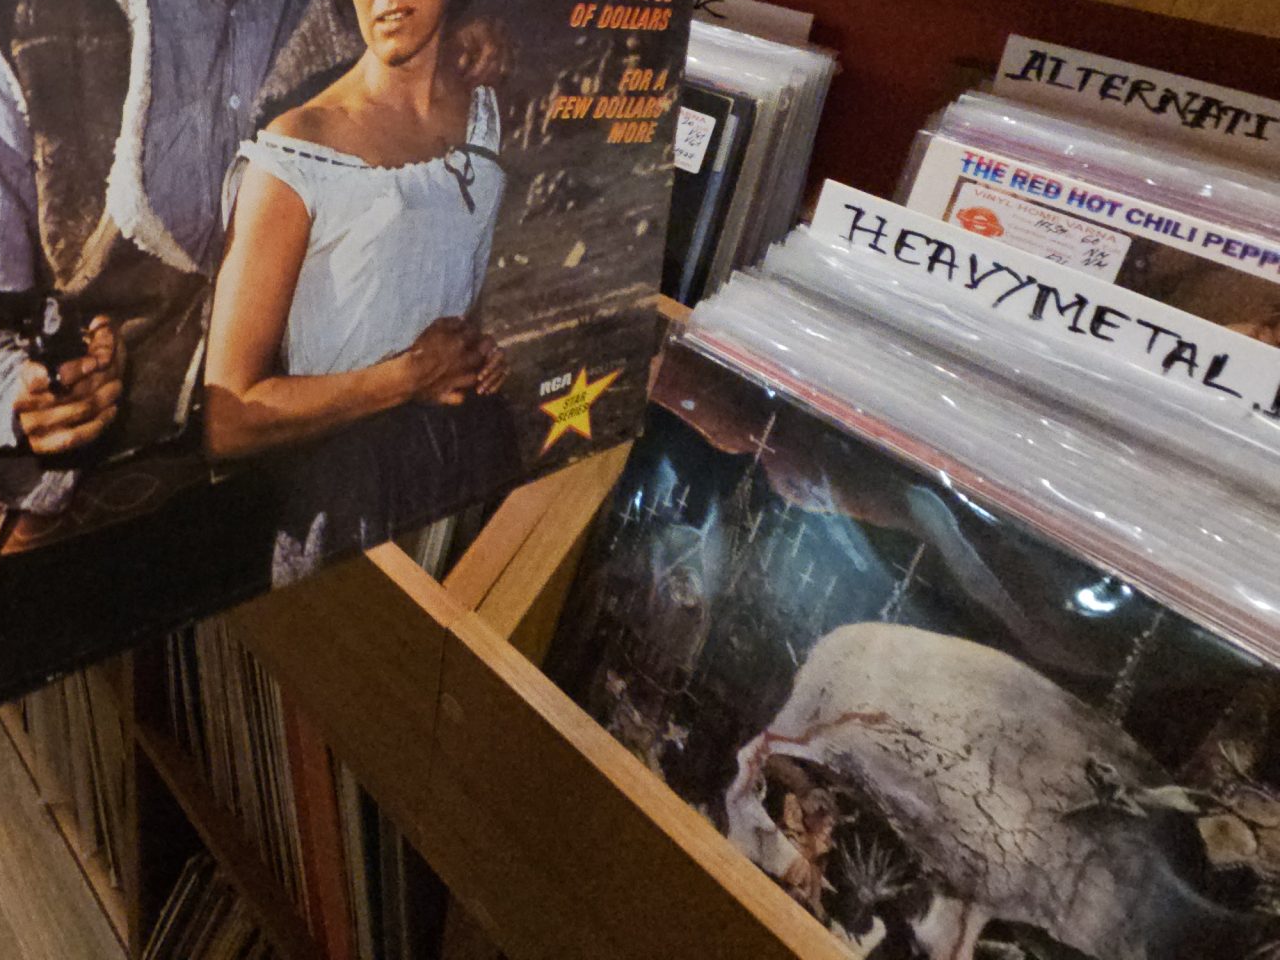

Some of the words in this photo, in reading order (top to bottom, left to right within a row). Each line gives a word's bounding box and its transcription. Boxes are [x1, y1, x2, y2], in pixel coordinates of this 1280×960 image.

[570, 3, 597, 28] OF
[597, 5, 672, 30] DOLLARS
[619, 69, 651, 90] FOR
[653, 69, 668, 91] A
[551, 96, 593, 119] FEW
[593, 96, 665, 120] DOLLARS
[607, 121, 658, 144] MORE
[961, 151, 1009, 184] THE
[1008, 168, 1062, 201] RED
[1066, 186, 1123, 218] HOT
[1125, 208, 1197, 243] CHILI
[1202, 232, 1280, 275] PEPP
[974, 188, 1013, 213] VINYL
[1016, 200, 1060, 225] HOME
[1064, 218, 1117, 243] VARNA
[540, 372, 572, 397] RCA
